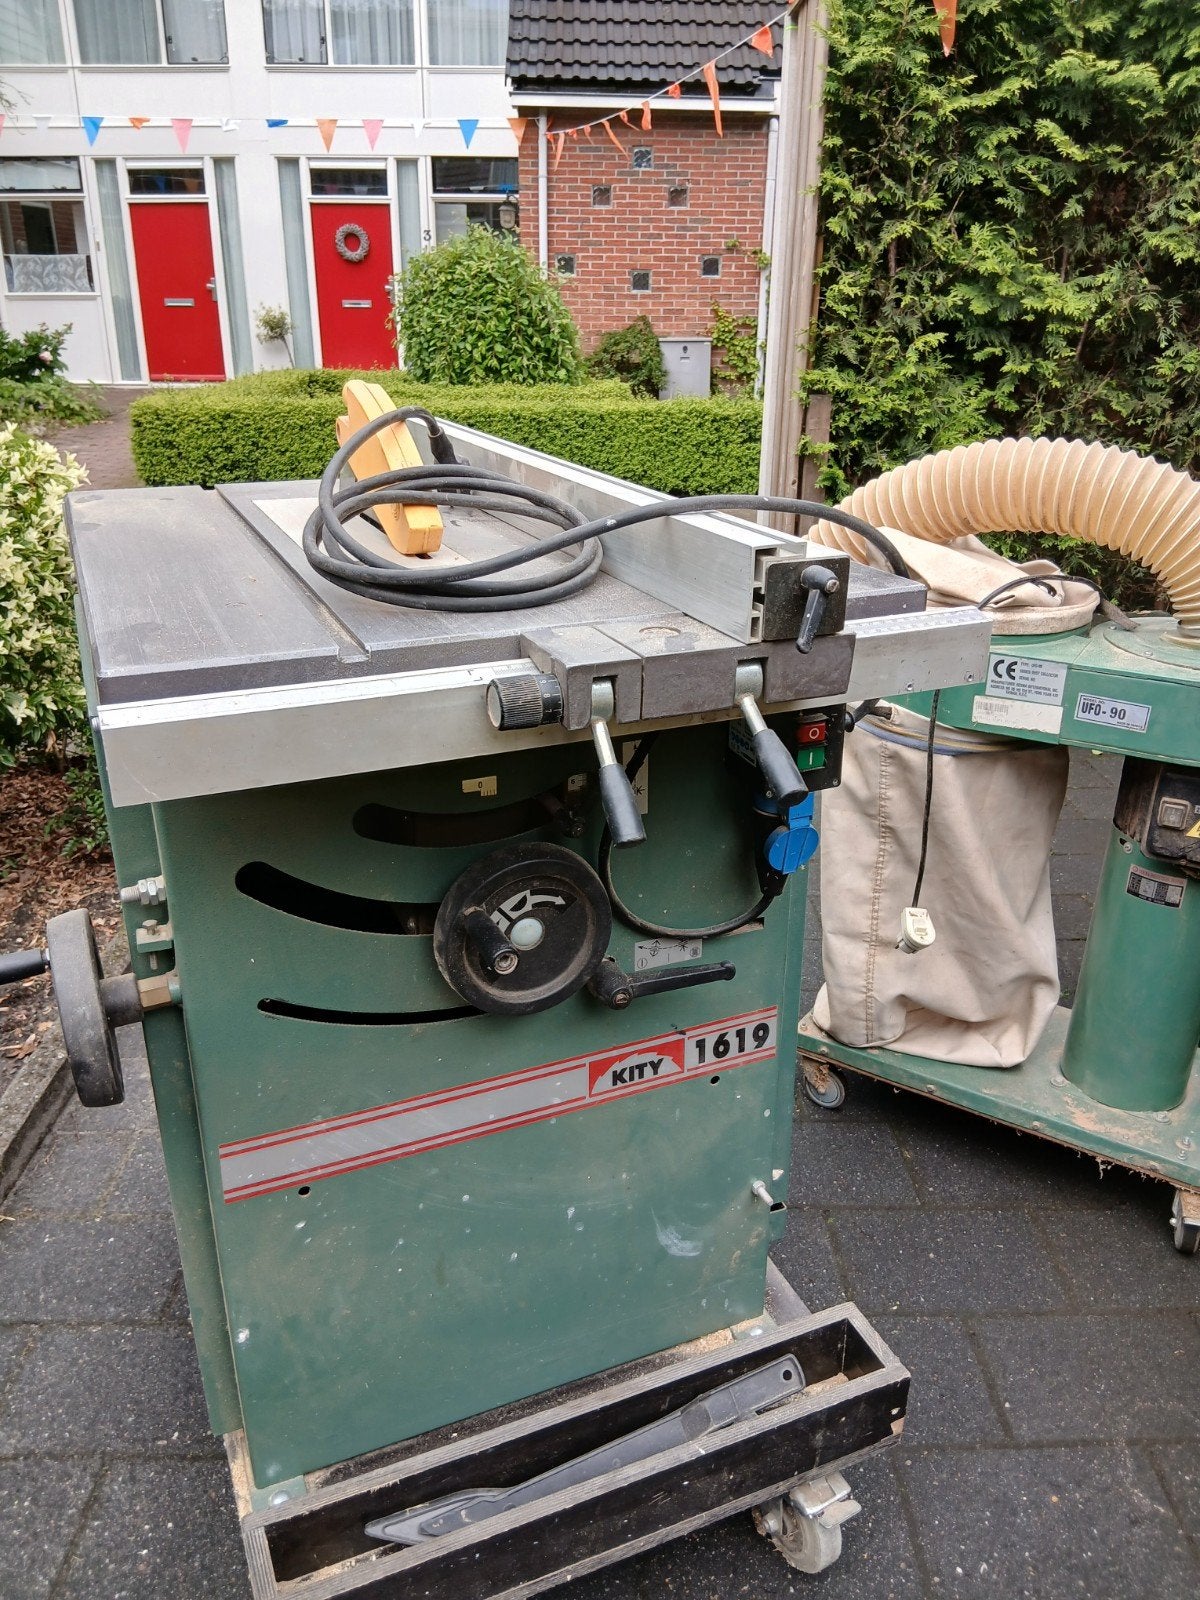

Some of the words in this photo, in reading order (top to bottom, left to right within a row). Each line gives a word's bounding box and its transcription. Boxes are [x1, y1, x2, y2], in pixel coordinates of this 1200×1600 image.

[993, 659, 1018, 680] CE
[1110, 707, 1126, 720] 90
[612, 1058, 664, 1086] KITY
[696, 1022, 770, 1064] 1619
